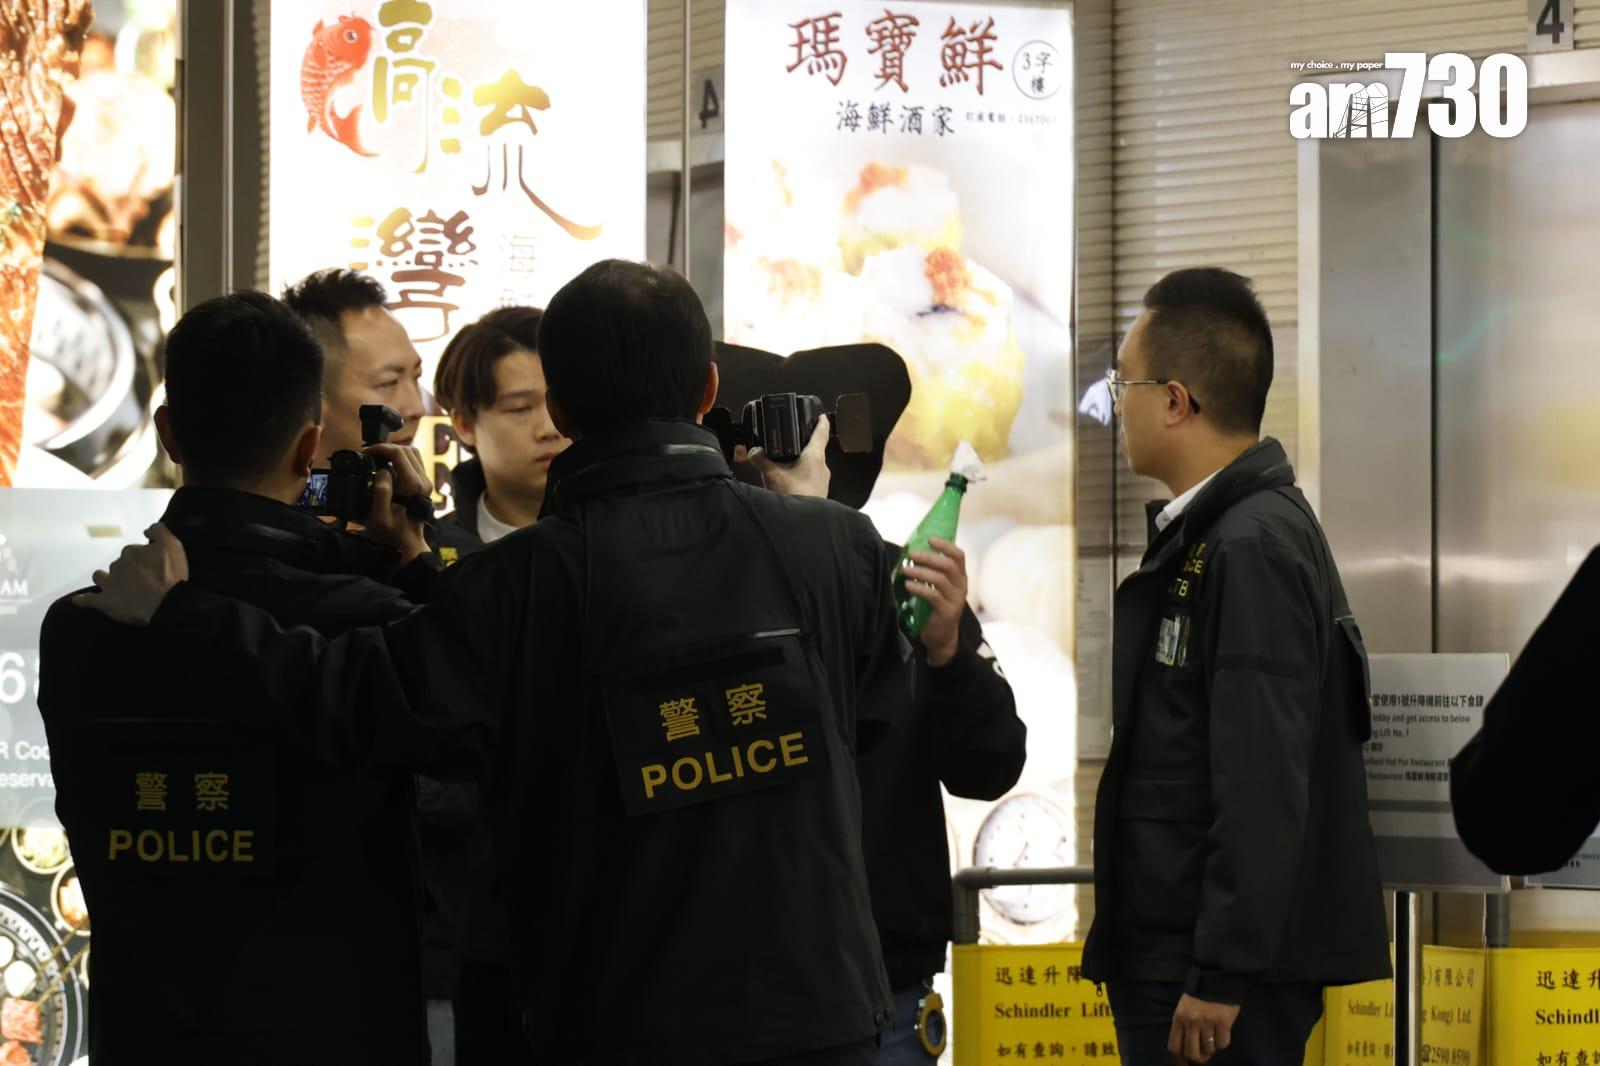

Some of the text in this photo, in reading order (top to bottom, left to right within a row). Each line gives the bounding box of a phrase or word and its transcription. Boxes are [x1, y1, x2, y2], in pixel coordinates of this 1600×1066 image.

[1536, 0, 1564, 44] 4
[785, 10, 1004, 95] 瑪寶鮮
[836, 100, 956, 137] 海鮮酒家
[658, 683, 769, 742] 警察
[1392, 714, 1405, 722] and
[1406, 715, 1418, 725] get
[1419, 715, 1440, 723] access
[1441, 715, 1449, 723] to
[1450, 713, 1471, 723] below
[640, 731, 809, 800] POLICE
[135, 771, 230, 812] 警察
[108, 829, 254, 863] POLICE
[995, 1002, 1072, 1019] Schindler
[1347, 1000, 1381, 1017] Schindler
[1535, 1007, 1600, 1025] Schindl
